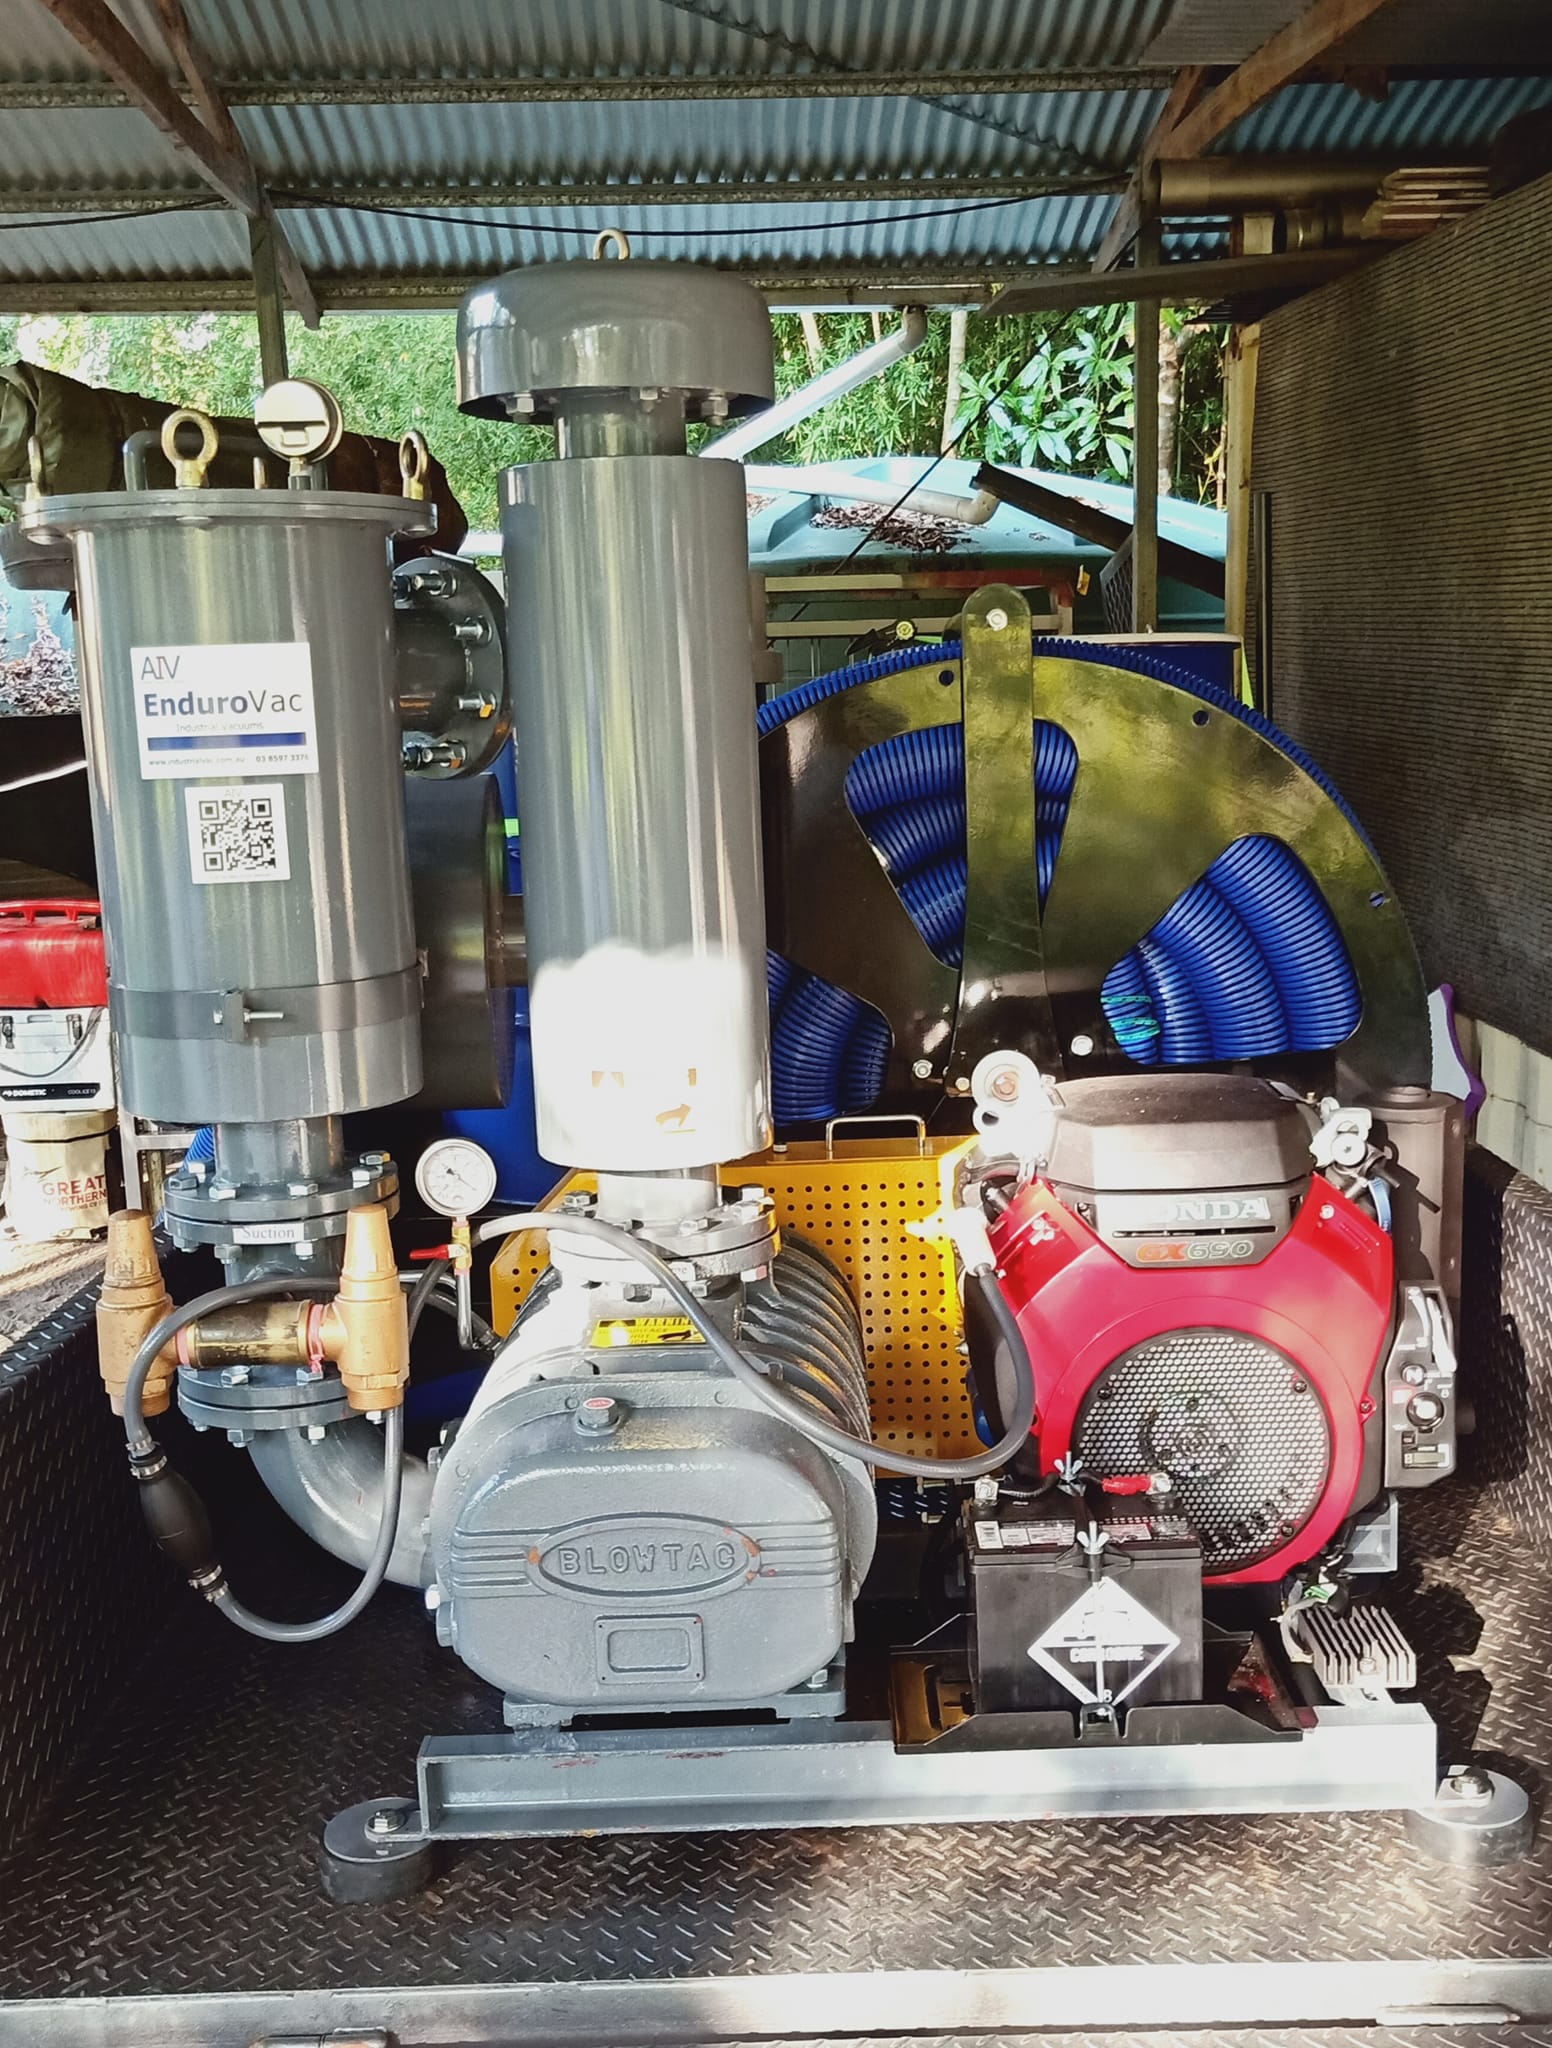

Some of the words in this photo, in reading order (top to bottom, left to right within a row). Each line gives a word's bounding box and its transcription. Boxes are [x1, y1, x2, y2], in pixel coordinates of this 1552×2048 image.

[144, 690, 303, 717] EnduroVac
[13, 1089, 47, 1097] DOMETIC
[43, 1175, 105, 1195] GREAT
[242, 1227, 295, 1239] Suction
[1136, 1239, 1254, 1263] GX690
[1103, 1689, 1113, 1703] 8
